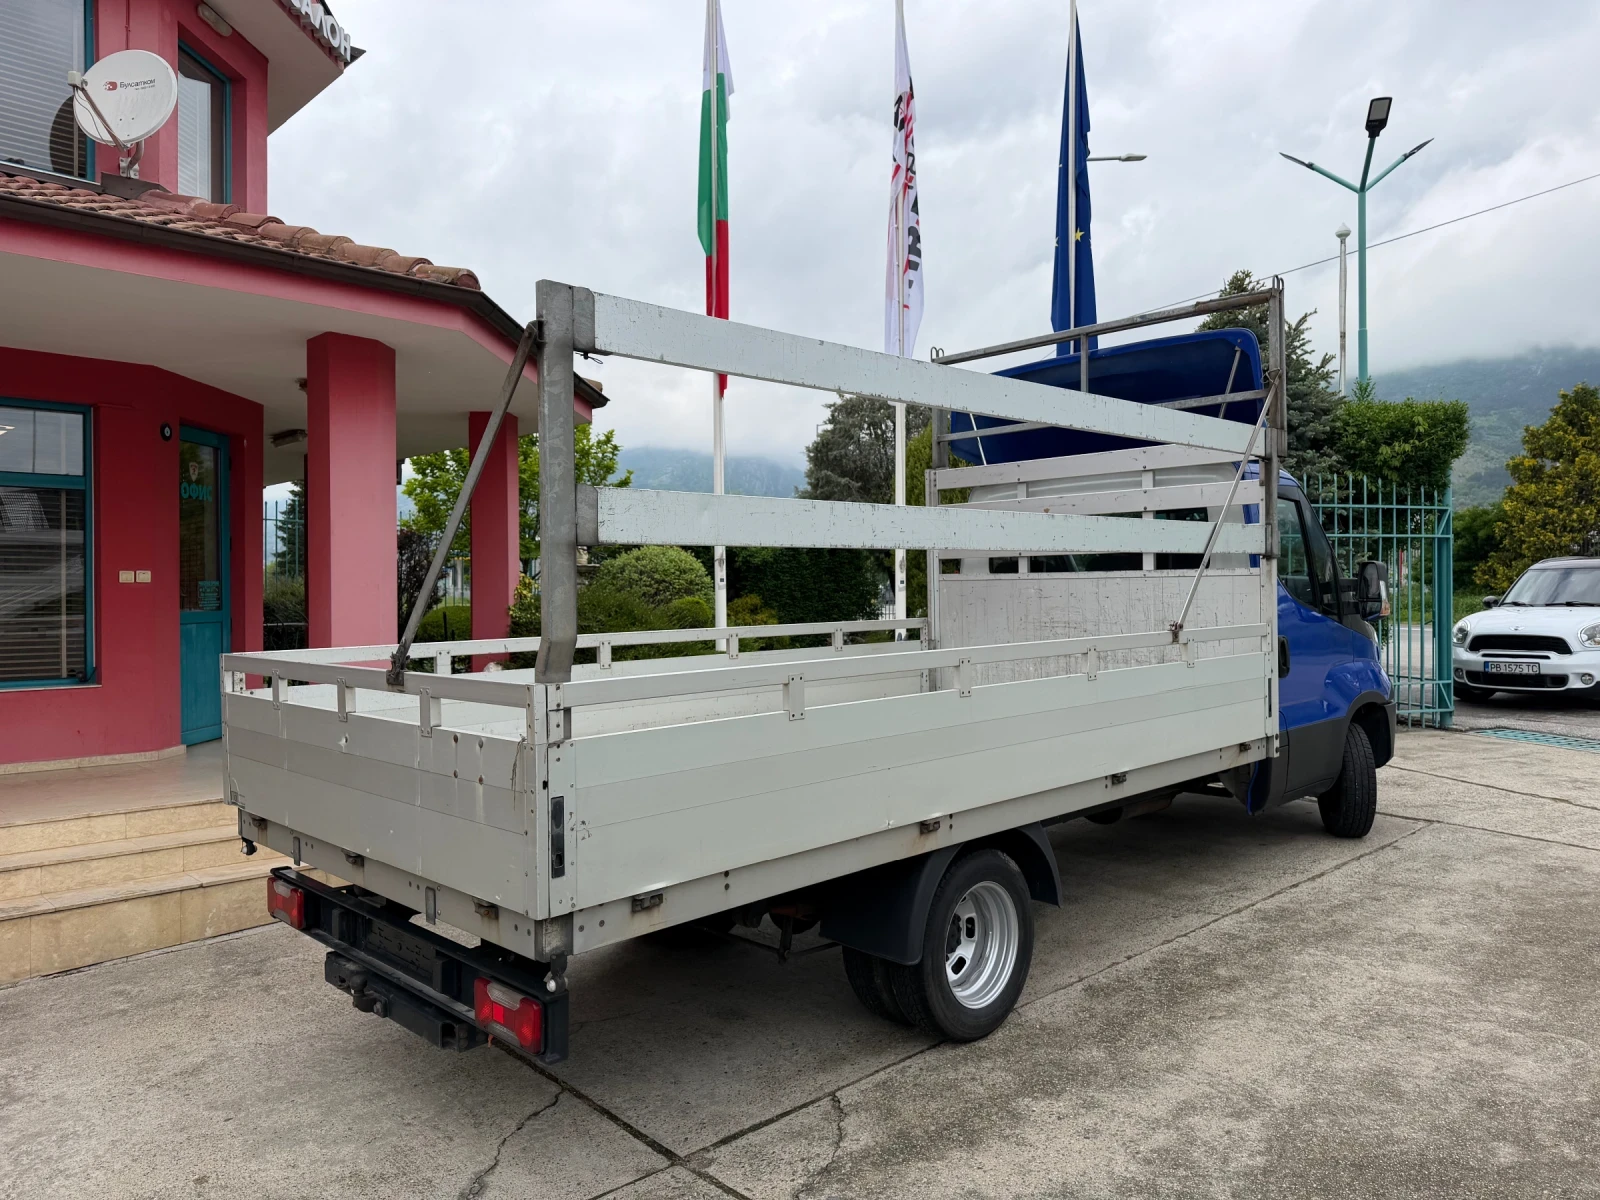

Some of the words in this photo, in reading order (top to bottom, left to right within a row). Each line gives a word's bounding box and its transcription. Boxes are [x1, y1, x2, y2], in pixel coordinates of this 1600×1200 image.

[180, 482, 213, 502] ОФИС
[1490, 663, 1502, 672] PB
[1504, 663, 1524, 673] 1575
[1525, 664, 1538, 673] TC
